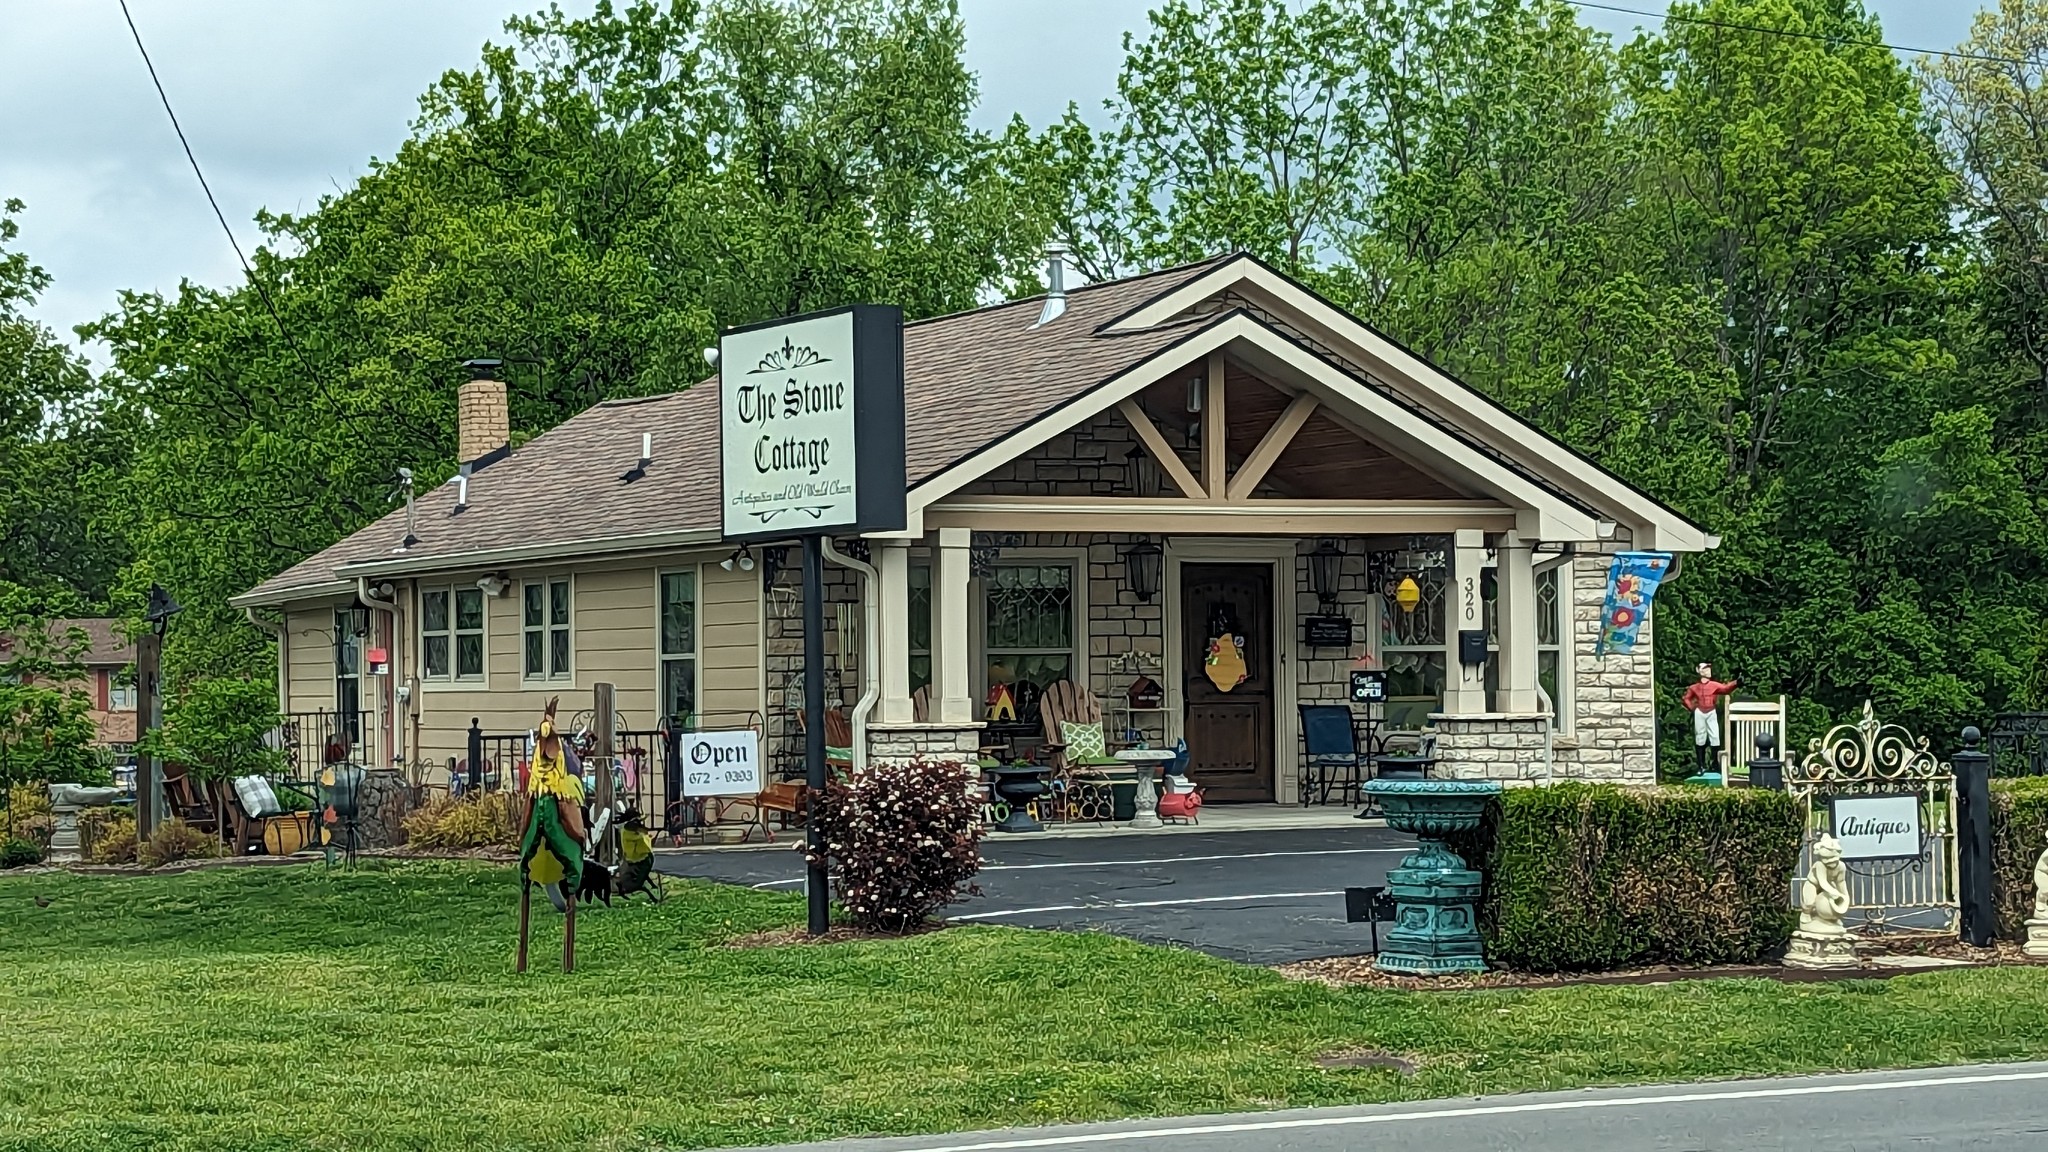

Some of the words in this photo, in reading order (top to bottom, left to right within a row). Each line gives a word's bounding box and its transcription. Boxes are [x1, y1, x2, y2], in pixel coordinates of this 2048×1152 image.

[736, 383, 777, 430] The
[783, 377, 845, 420] Stone
[754, 434, 830, 476] Cottage
[1464, 577, 1475, 621] 320
[690, 741, 748, 767] Open
[1840, 816, 1911, 844] Antiques
